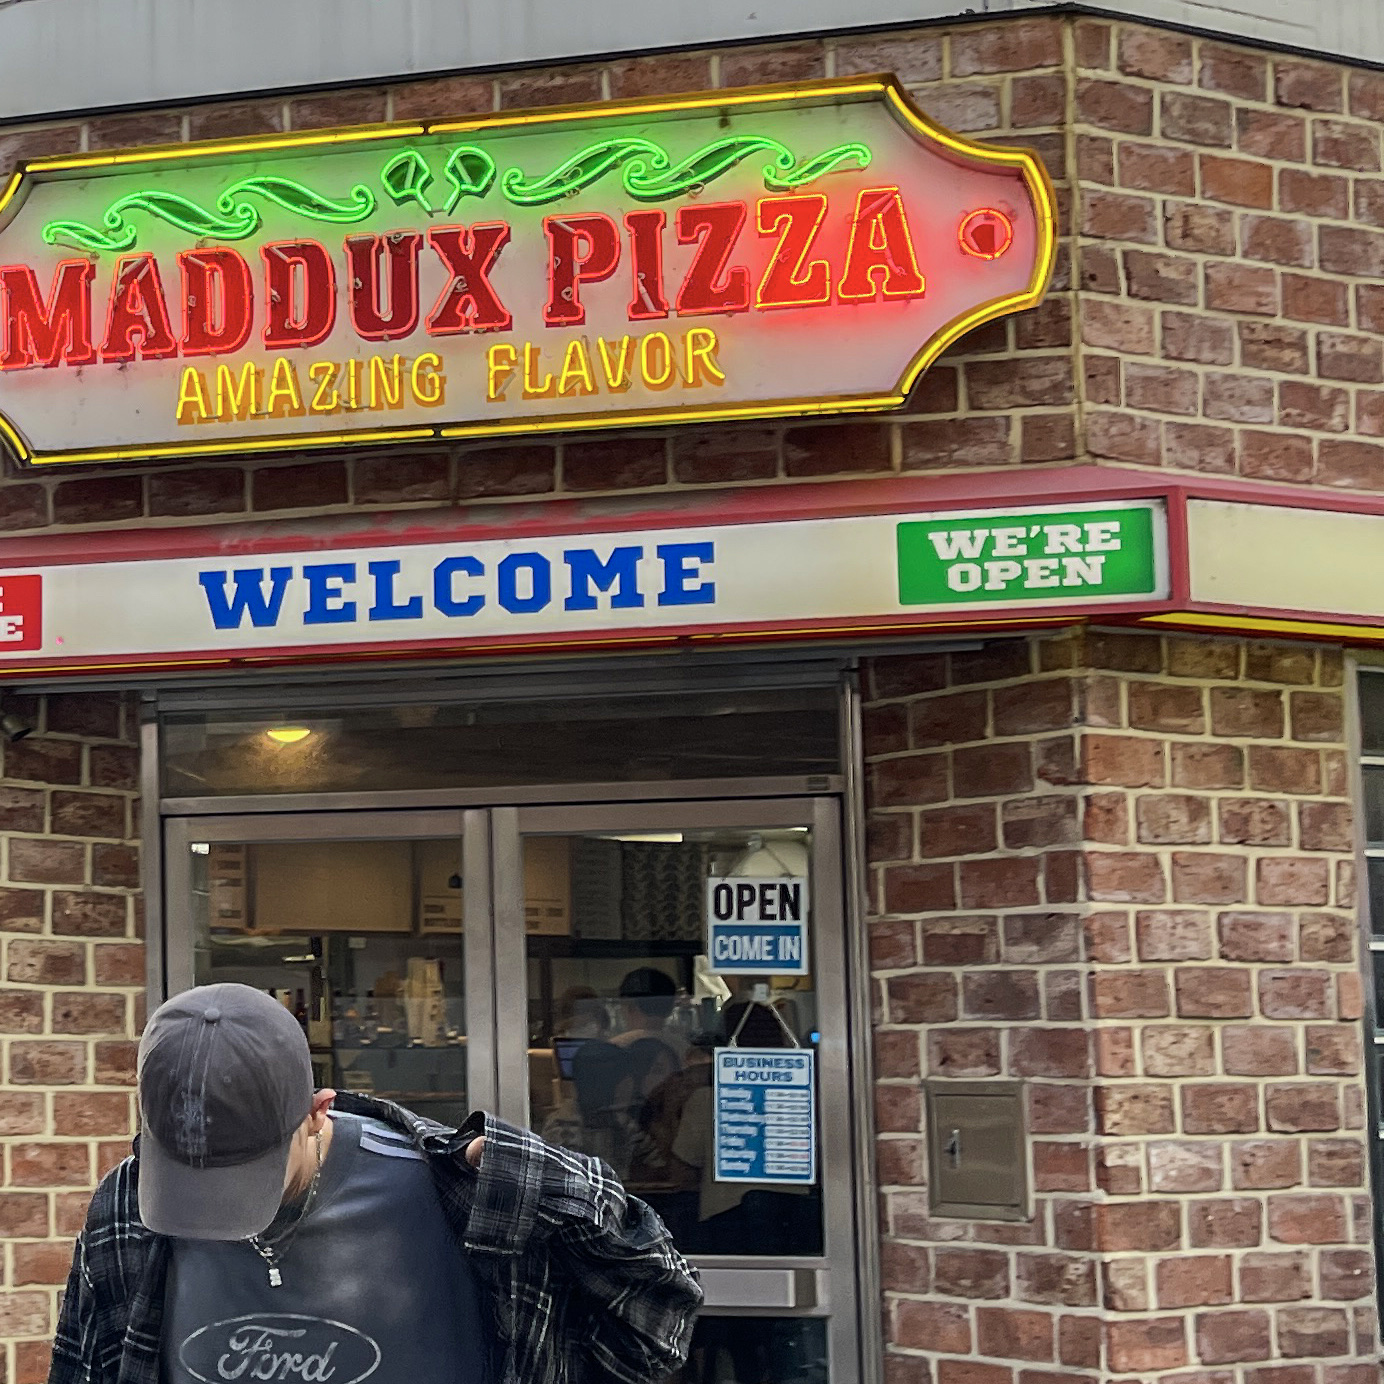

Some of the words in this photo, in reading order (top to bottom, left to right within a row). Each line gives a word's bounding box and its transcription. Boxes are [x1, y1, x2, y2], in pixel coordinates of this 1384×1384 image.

[543, 186, 926, 328] PIZZA
[176, 351, 446, 426] AMAZING
[486, 327, 726, 403] FLAVOR
[927, 520, 1122, 560] WE'RE
[199, 541, 716, 630] WELCOME
[946, 555, 1106, 593] OPEN
[714, 883, 801, 921] OPEN
[714, 934, 774, 961] COME
[779, 935, 801, 961] IN
[723, 1057, 805, 1069] BUSINESS
[735, 1070, 793, 1082] HOURS
[217, 1325, 339, 1383] Ford
